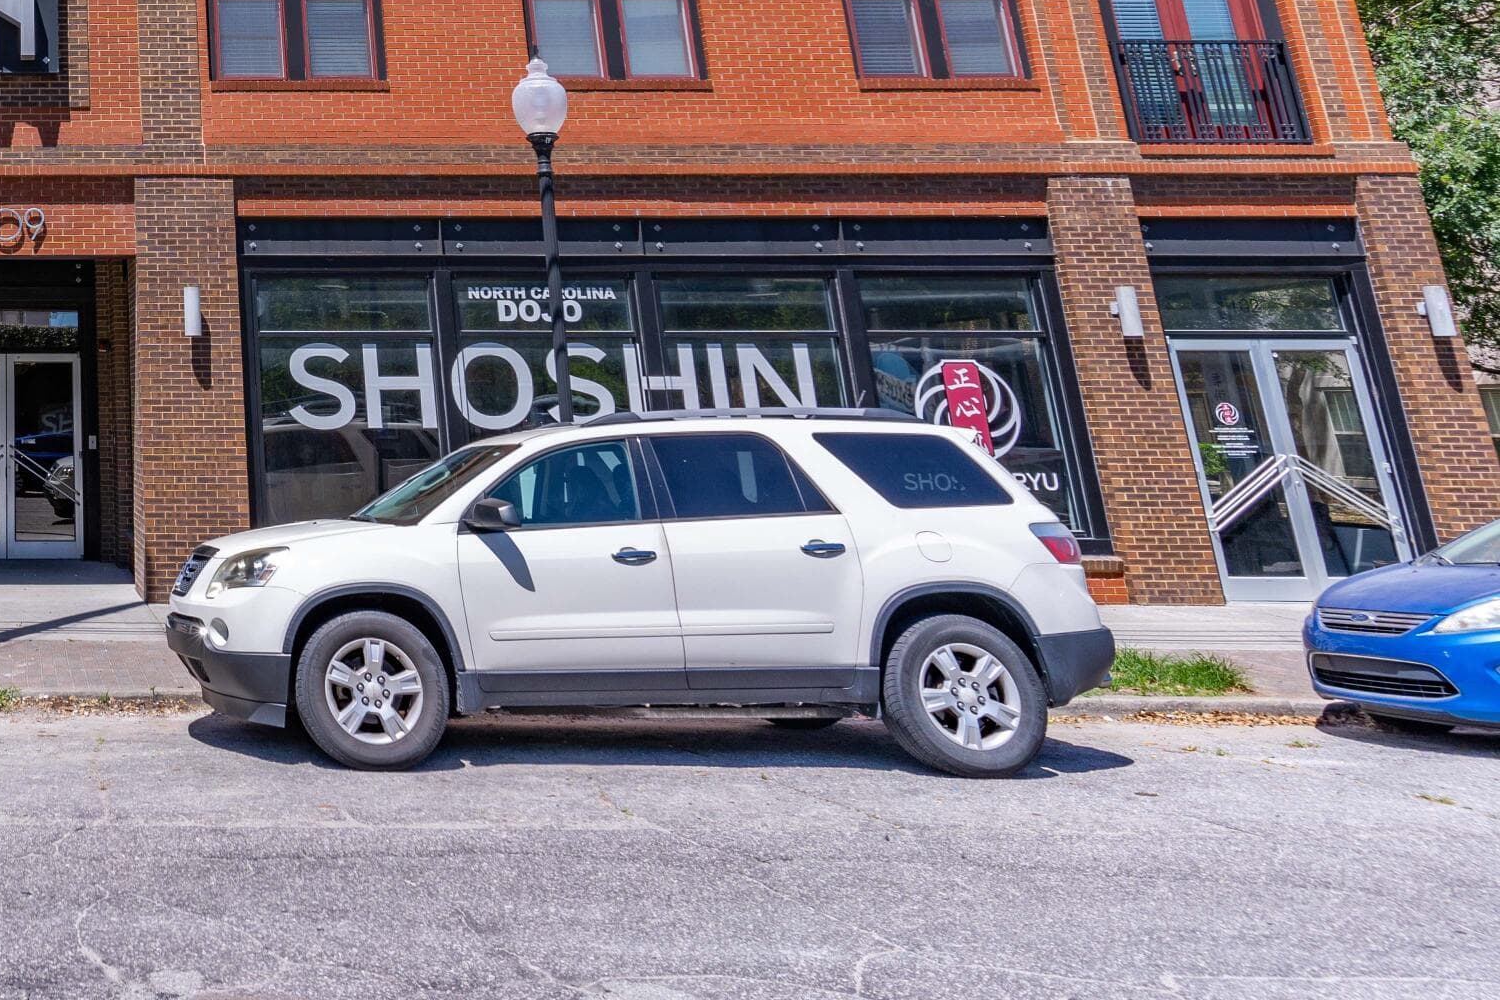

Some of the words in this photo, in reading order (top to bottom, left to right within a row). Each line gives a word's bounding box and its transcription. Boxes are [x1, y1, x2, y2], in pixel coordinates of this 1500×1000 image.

[467, 286, 526, 300] NORTH
[530, 286, 617, 300] CAOLINA
[288, 342, 818, 430] SHOSHIN
